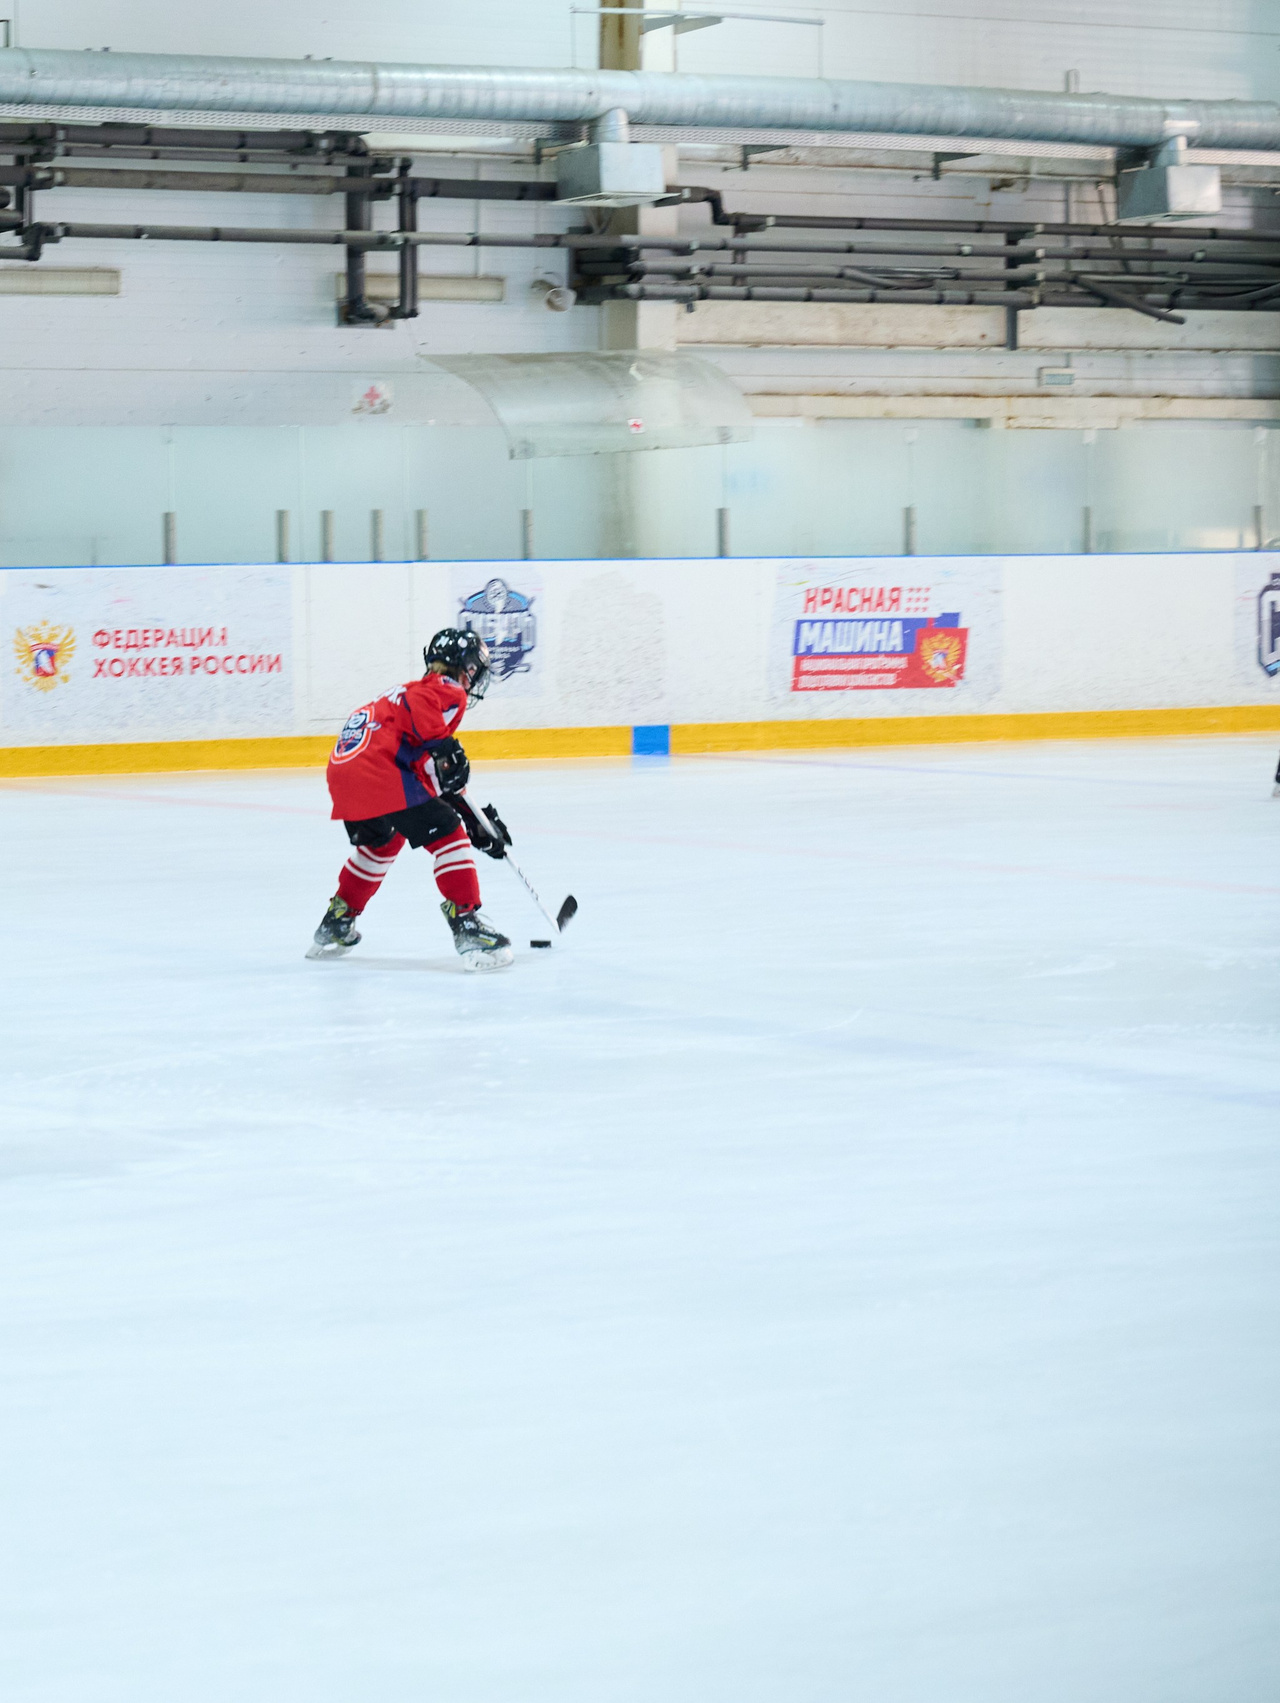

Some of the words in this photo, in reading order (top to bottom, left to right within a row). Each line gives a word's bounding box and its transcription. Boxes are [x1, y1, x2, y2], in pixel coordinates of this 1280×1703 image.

[803, 586, 902, 613] КРАСНАЯ
[798, 620, 904, 653] МАШИНА
[92, 657, 184, 678] ХОККЕЯ
[189, 653, 282, 675] РОССИИ
